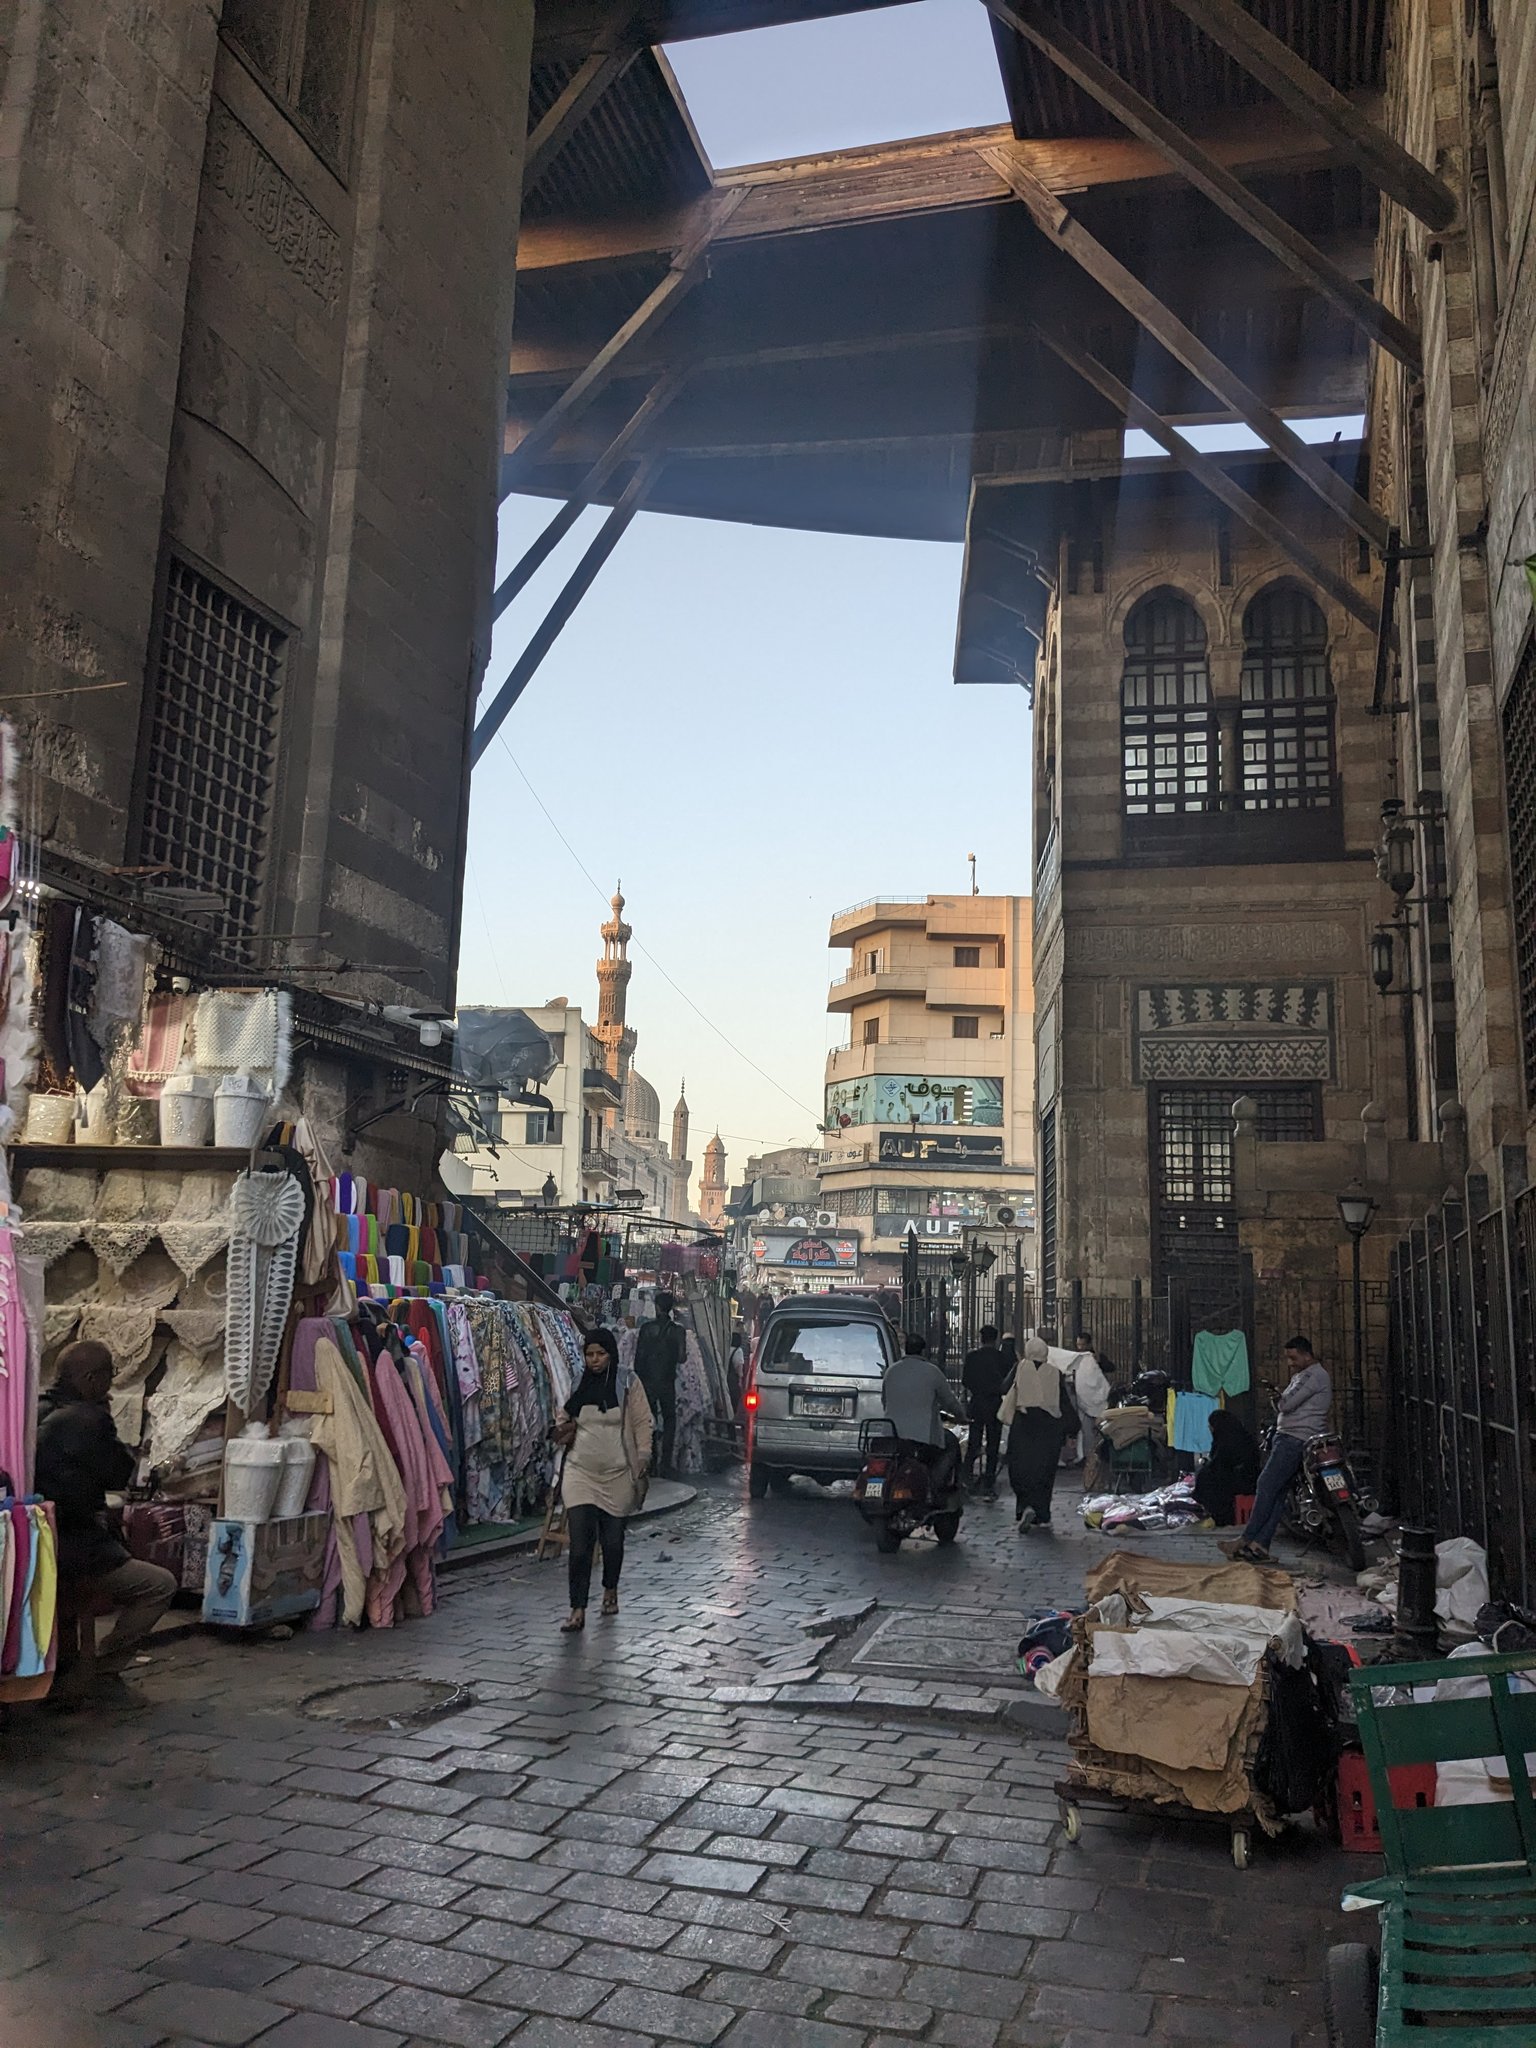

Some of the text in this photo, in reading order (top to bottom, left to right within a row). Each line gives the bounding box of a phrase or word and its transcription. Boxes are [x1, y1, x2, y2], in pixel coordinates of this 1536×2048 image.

[880, 1138, 938, 1159] AUF
[820, 1151, 833, 1164] AUF
[903, 1219, 960, 1236] AUF
